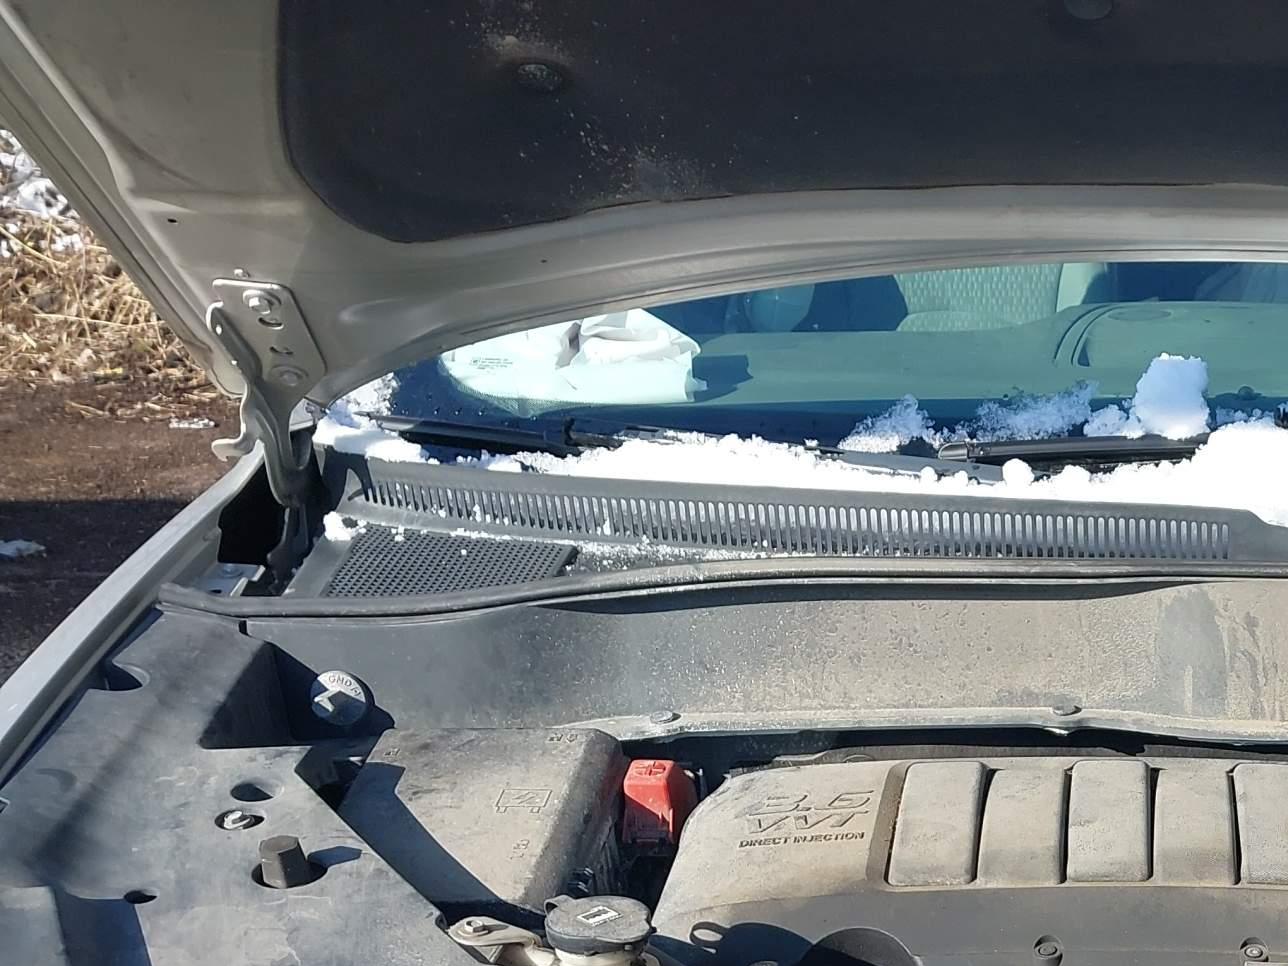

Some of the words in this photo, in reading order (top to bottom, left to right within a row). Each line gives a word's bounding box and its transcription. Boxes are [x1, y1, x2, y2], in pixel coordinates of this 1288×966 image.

[748, 790, 874, 817] 3.6
[747, 810, 869, 834] VVT
[739, 836, 791, 848] DIRECT
[793, 831, 865, 844] INJECTION
